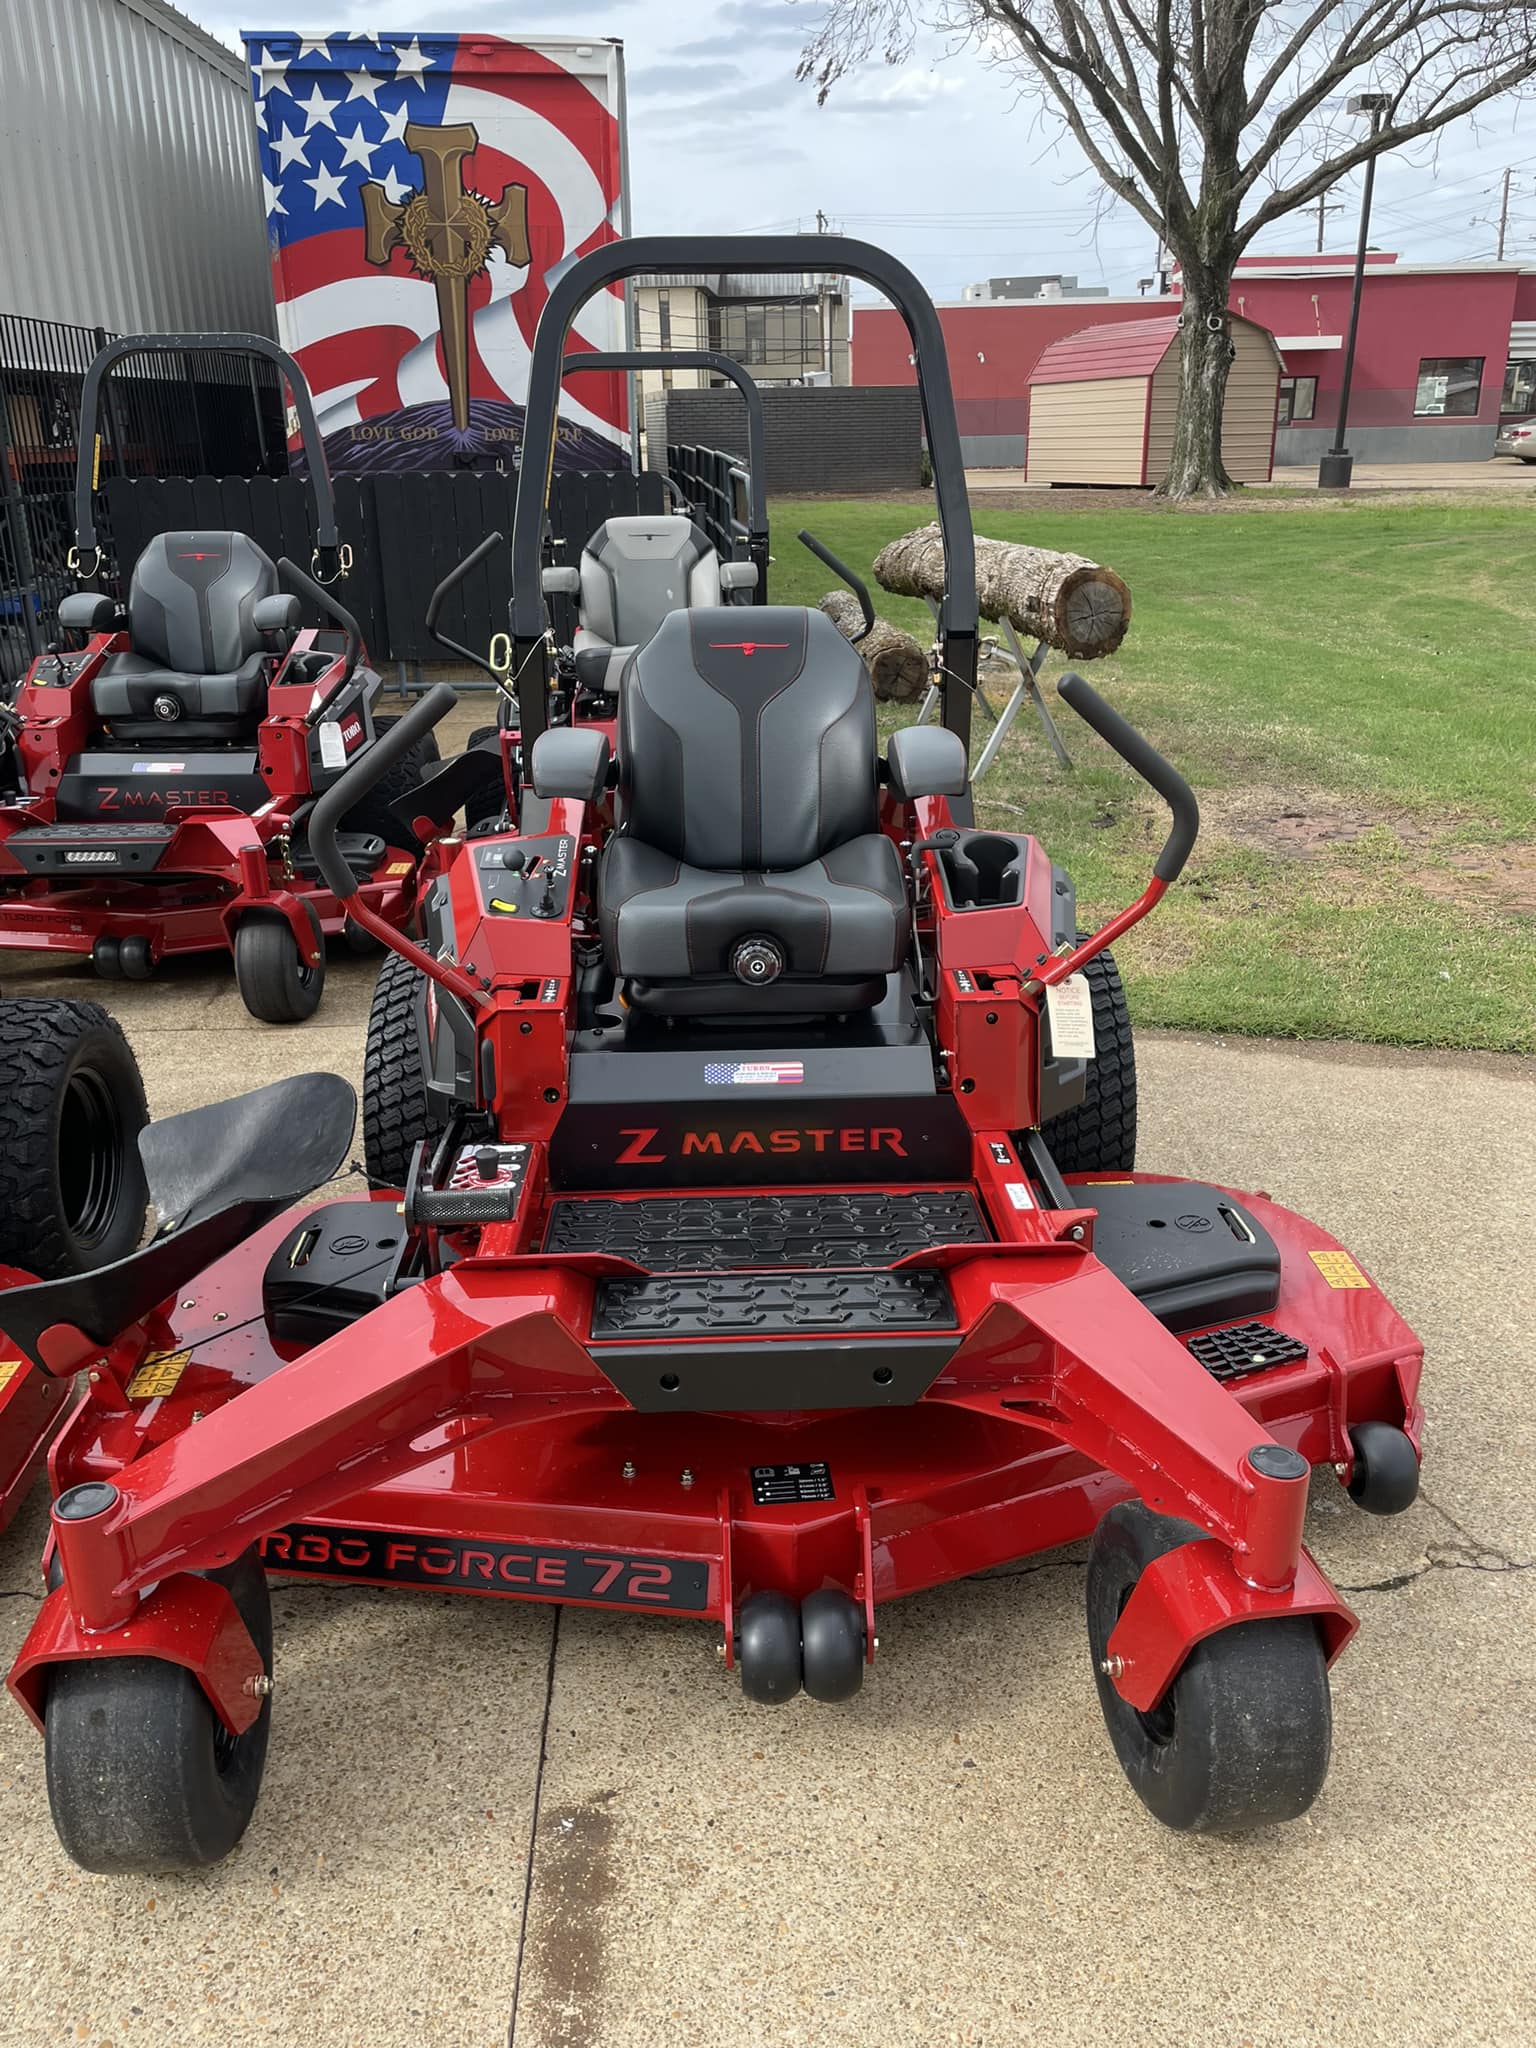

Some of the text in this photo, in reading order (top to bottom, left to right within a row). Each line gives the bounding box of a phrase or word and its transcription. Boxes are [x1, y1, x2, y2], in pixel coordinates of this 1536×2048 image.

[350, 427, 394, 441] LOVE
[400, 427, 438, 440] GOD
[484, 427, 519, 441] LOVE
[343, 721, 361, 742] TORO
[97, 787, 229, 809] Z MASTER
[552, 839, 569, 877] Z MASTER
[615, 1127, 909, 1164] Z MASTER
[258, 1531, 672, 1601] RBO FORCE 72
